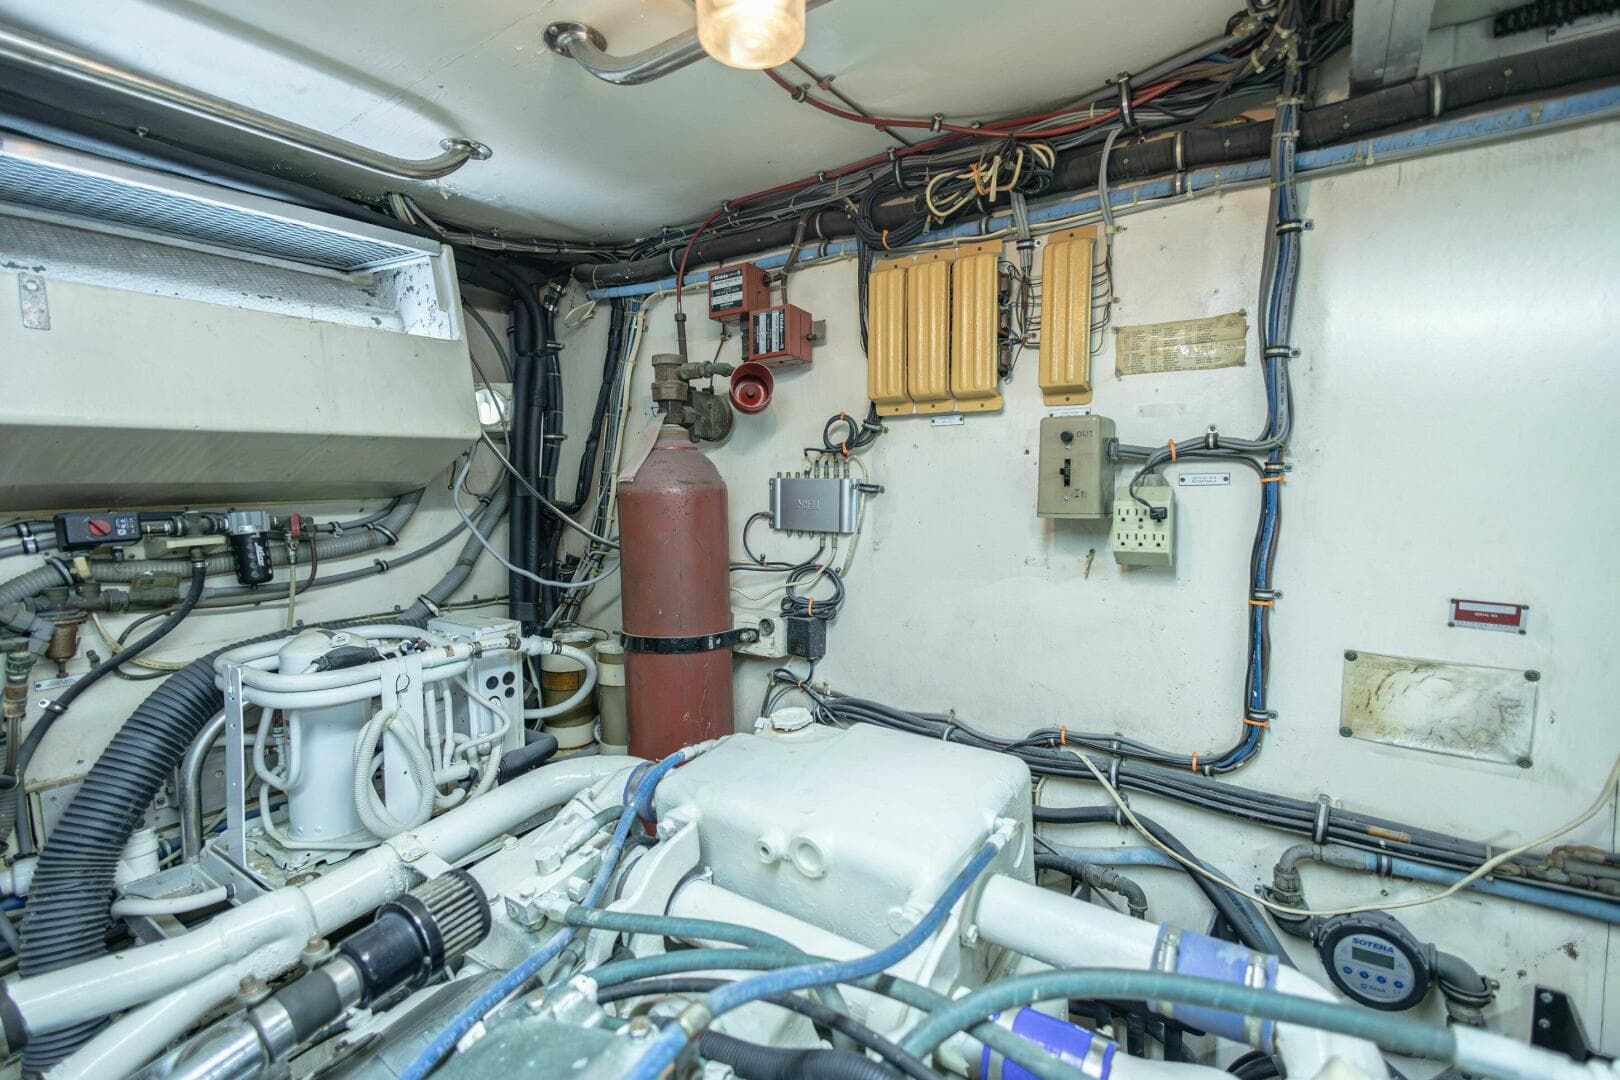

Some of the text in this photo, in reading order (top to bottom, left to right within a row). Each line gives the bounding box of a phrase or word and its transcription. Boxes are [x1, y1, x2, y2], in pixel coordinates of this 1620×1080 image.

[1076, 430, 1093, 438] OUT
[1074, 488, 1087, 499] In
[1352, 937, 1394, 953] SOTERA
